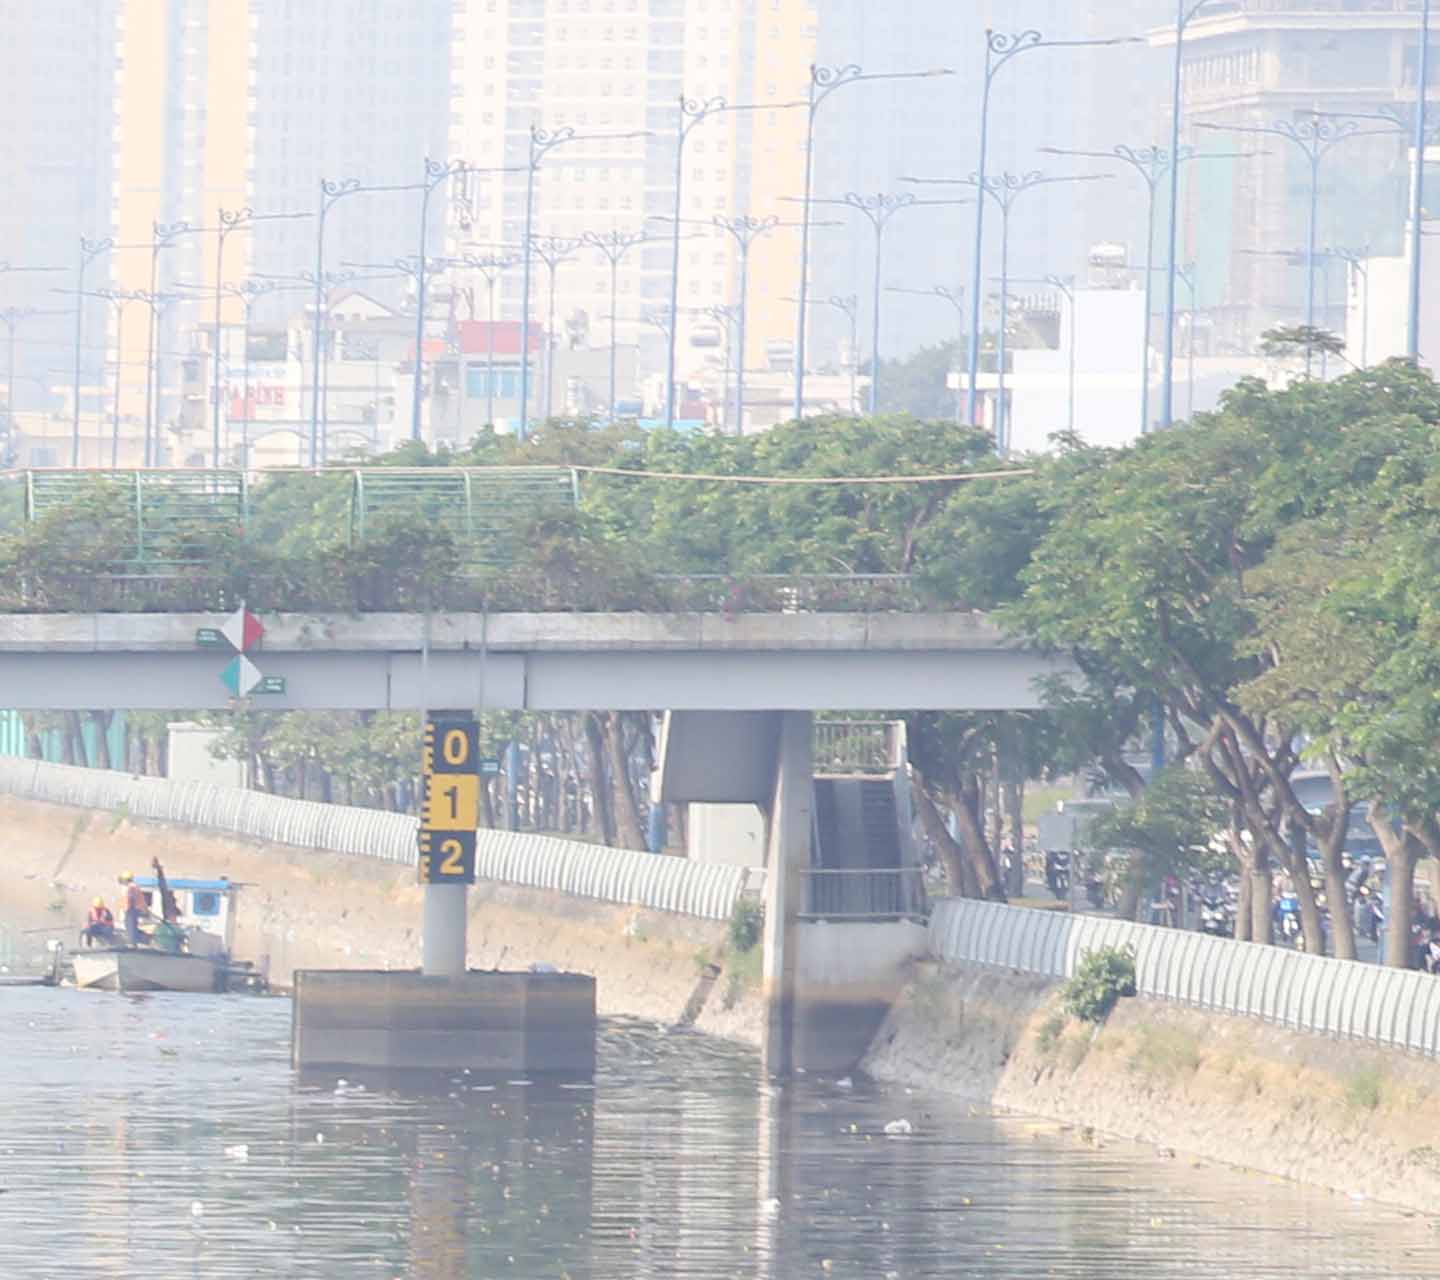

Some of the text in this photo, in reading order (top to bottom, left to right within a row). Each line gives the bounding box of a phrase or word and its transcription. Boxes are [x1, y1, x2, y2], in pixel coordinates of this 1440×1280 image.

[443, 729, 469, 766] 0
[443, 785, 458, 820] 1
[439, 838, 465, 875] 2
